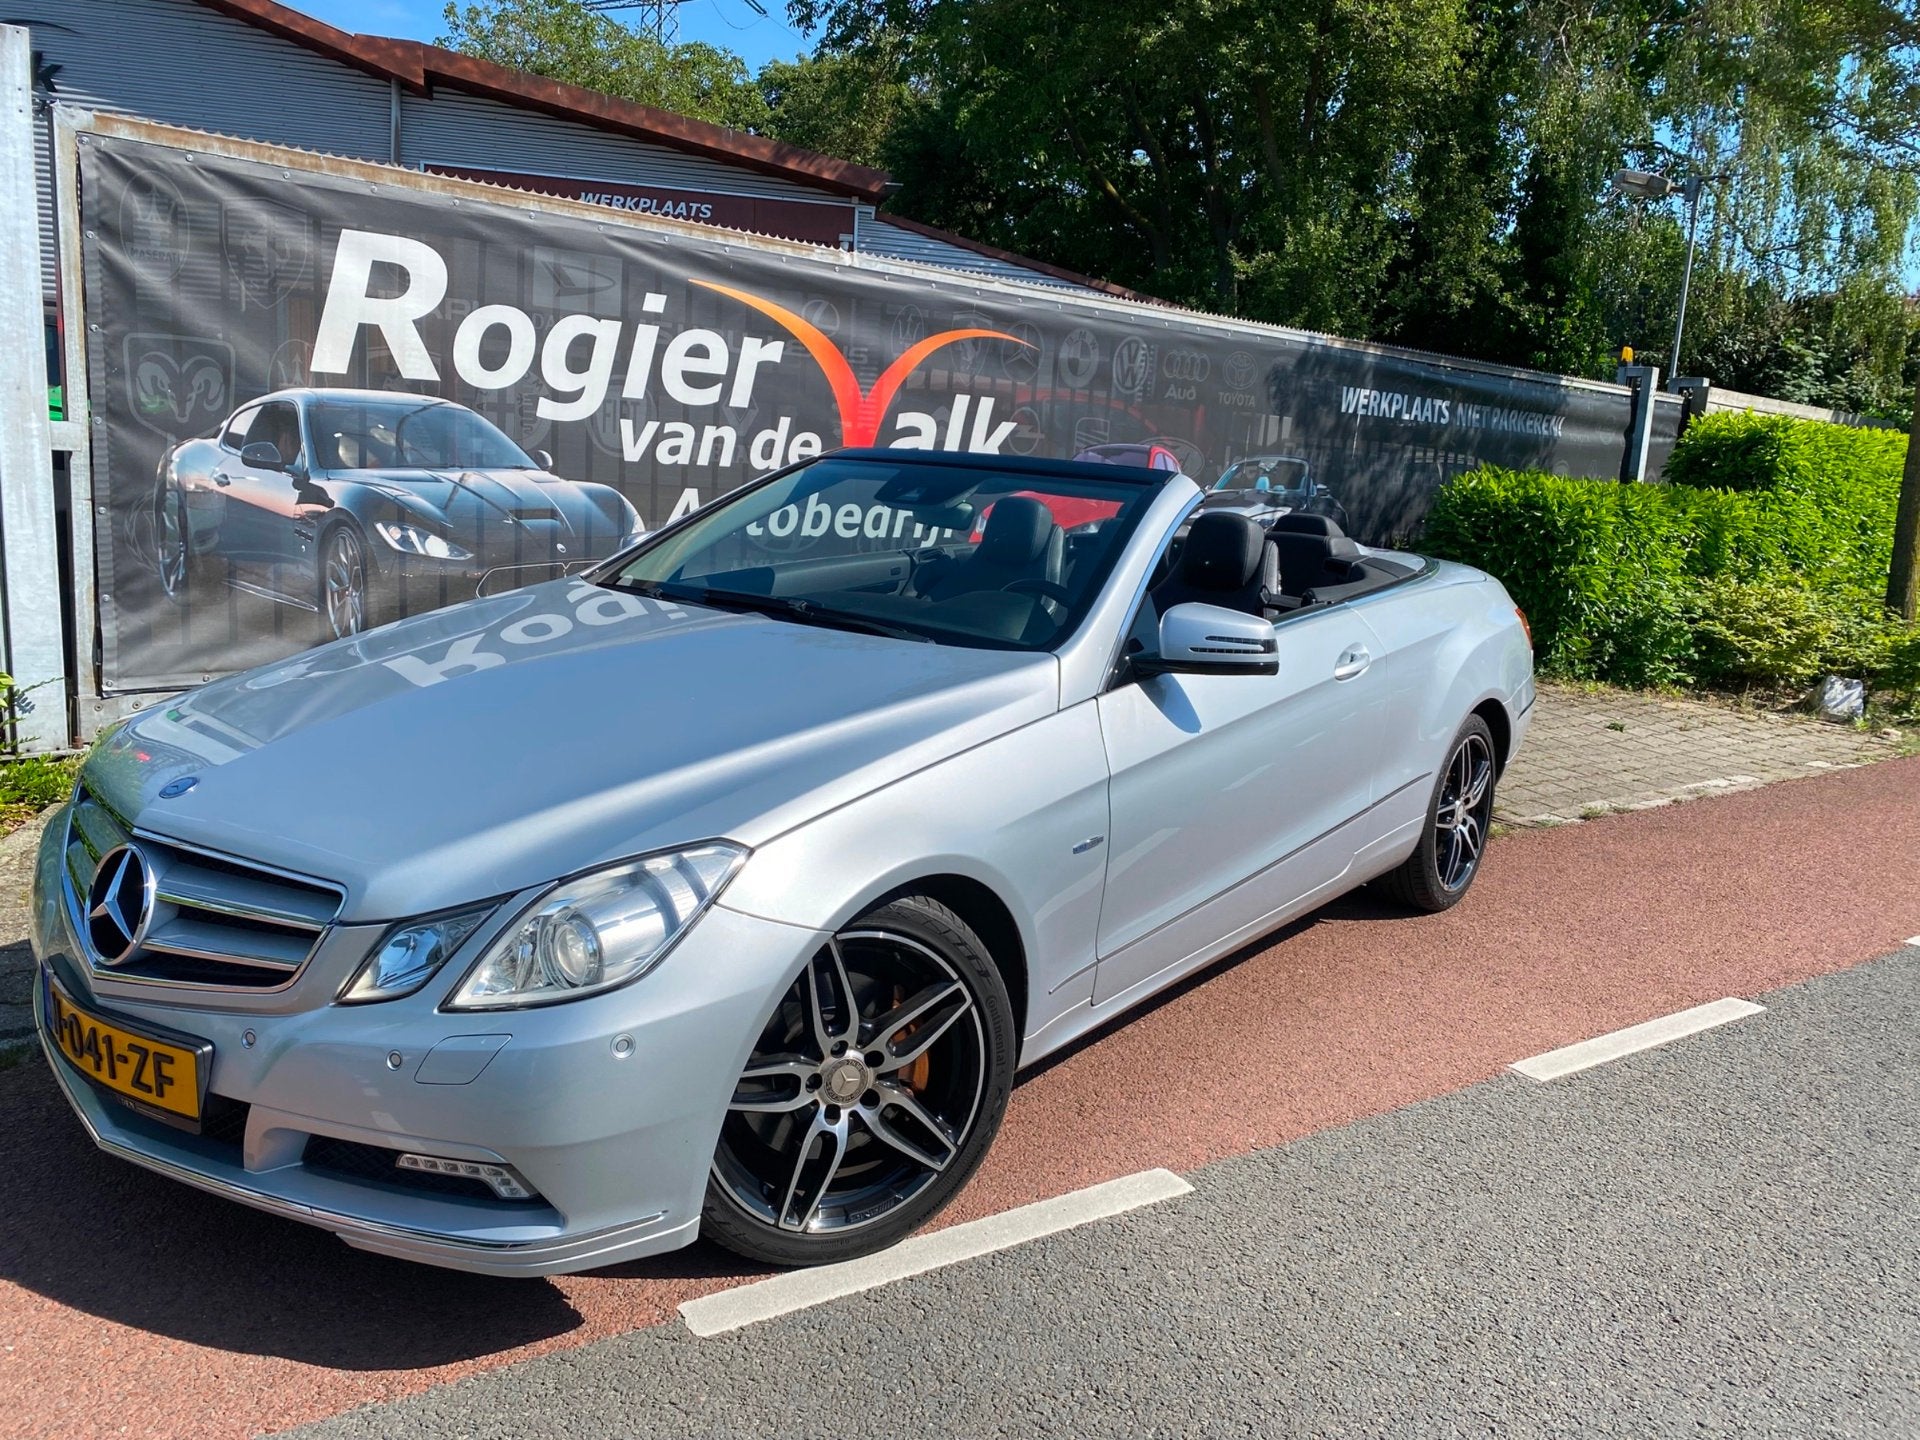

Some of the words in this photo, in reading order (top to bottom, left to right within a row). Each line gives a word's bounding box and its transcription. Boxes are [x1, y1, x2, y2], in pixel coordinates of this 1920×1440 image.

[580, 192, 713, 219] WERKPLAATS
[310, 228, 784, 421] Rogier
[1218, 391, 1257, 409] TOYOTA
[1340, 385, 1451, 425] WERKPLAATS
[1456, 402, 1492, 429] NIET
[1491, 406, 1566, 437] PARKEREN!
[620, 418, 737, 468] van
[749, 416, 823, 471] de
[985, 994, 1007, 1067] Continental
